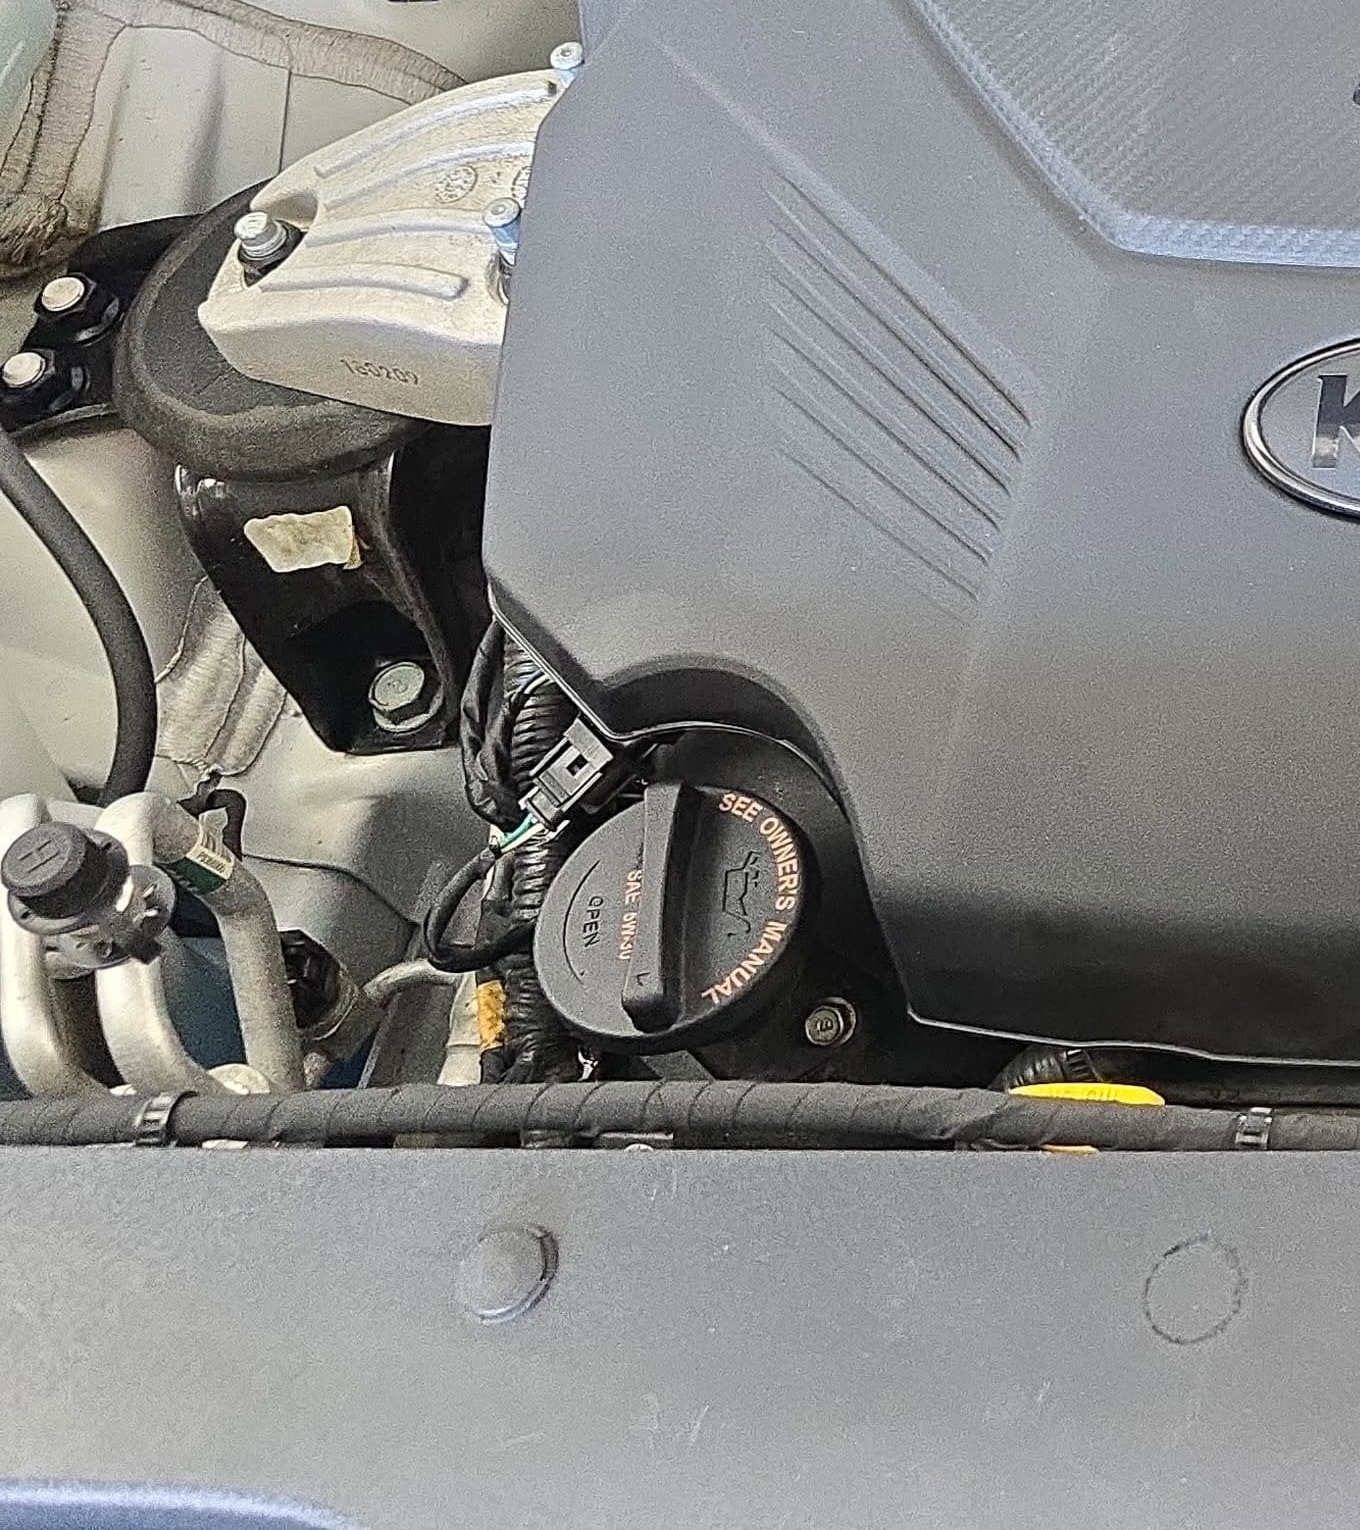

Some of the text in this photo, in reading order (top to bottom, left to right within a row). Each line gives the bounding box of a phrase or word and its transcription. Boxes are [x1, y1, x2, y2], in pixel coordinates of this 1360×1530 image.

[718, 792, 764, 823] SEE
[624, 869, 643, 906] SAE
[582, 895, 604, 948] OPEN
[701, 920, 788, 1005] MANUAL
